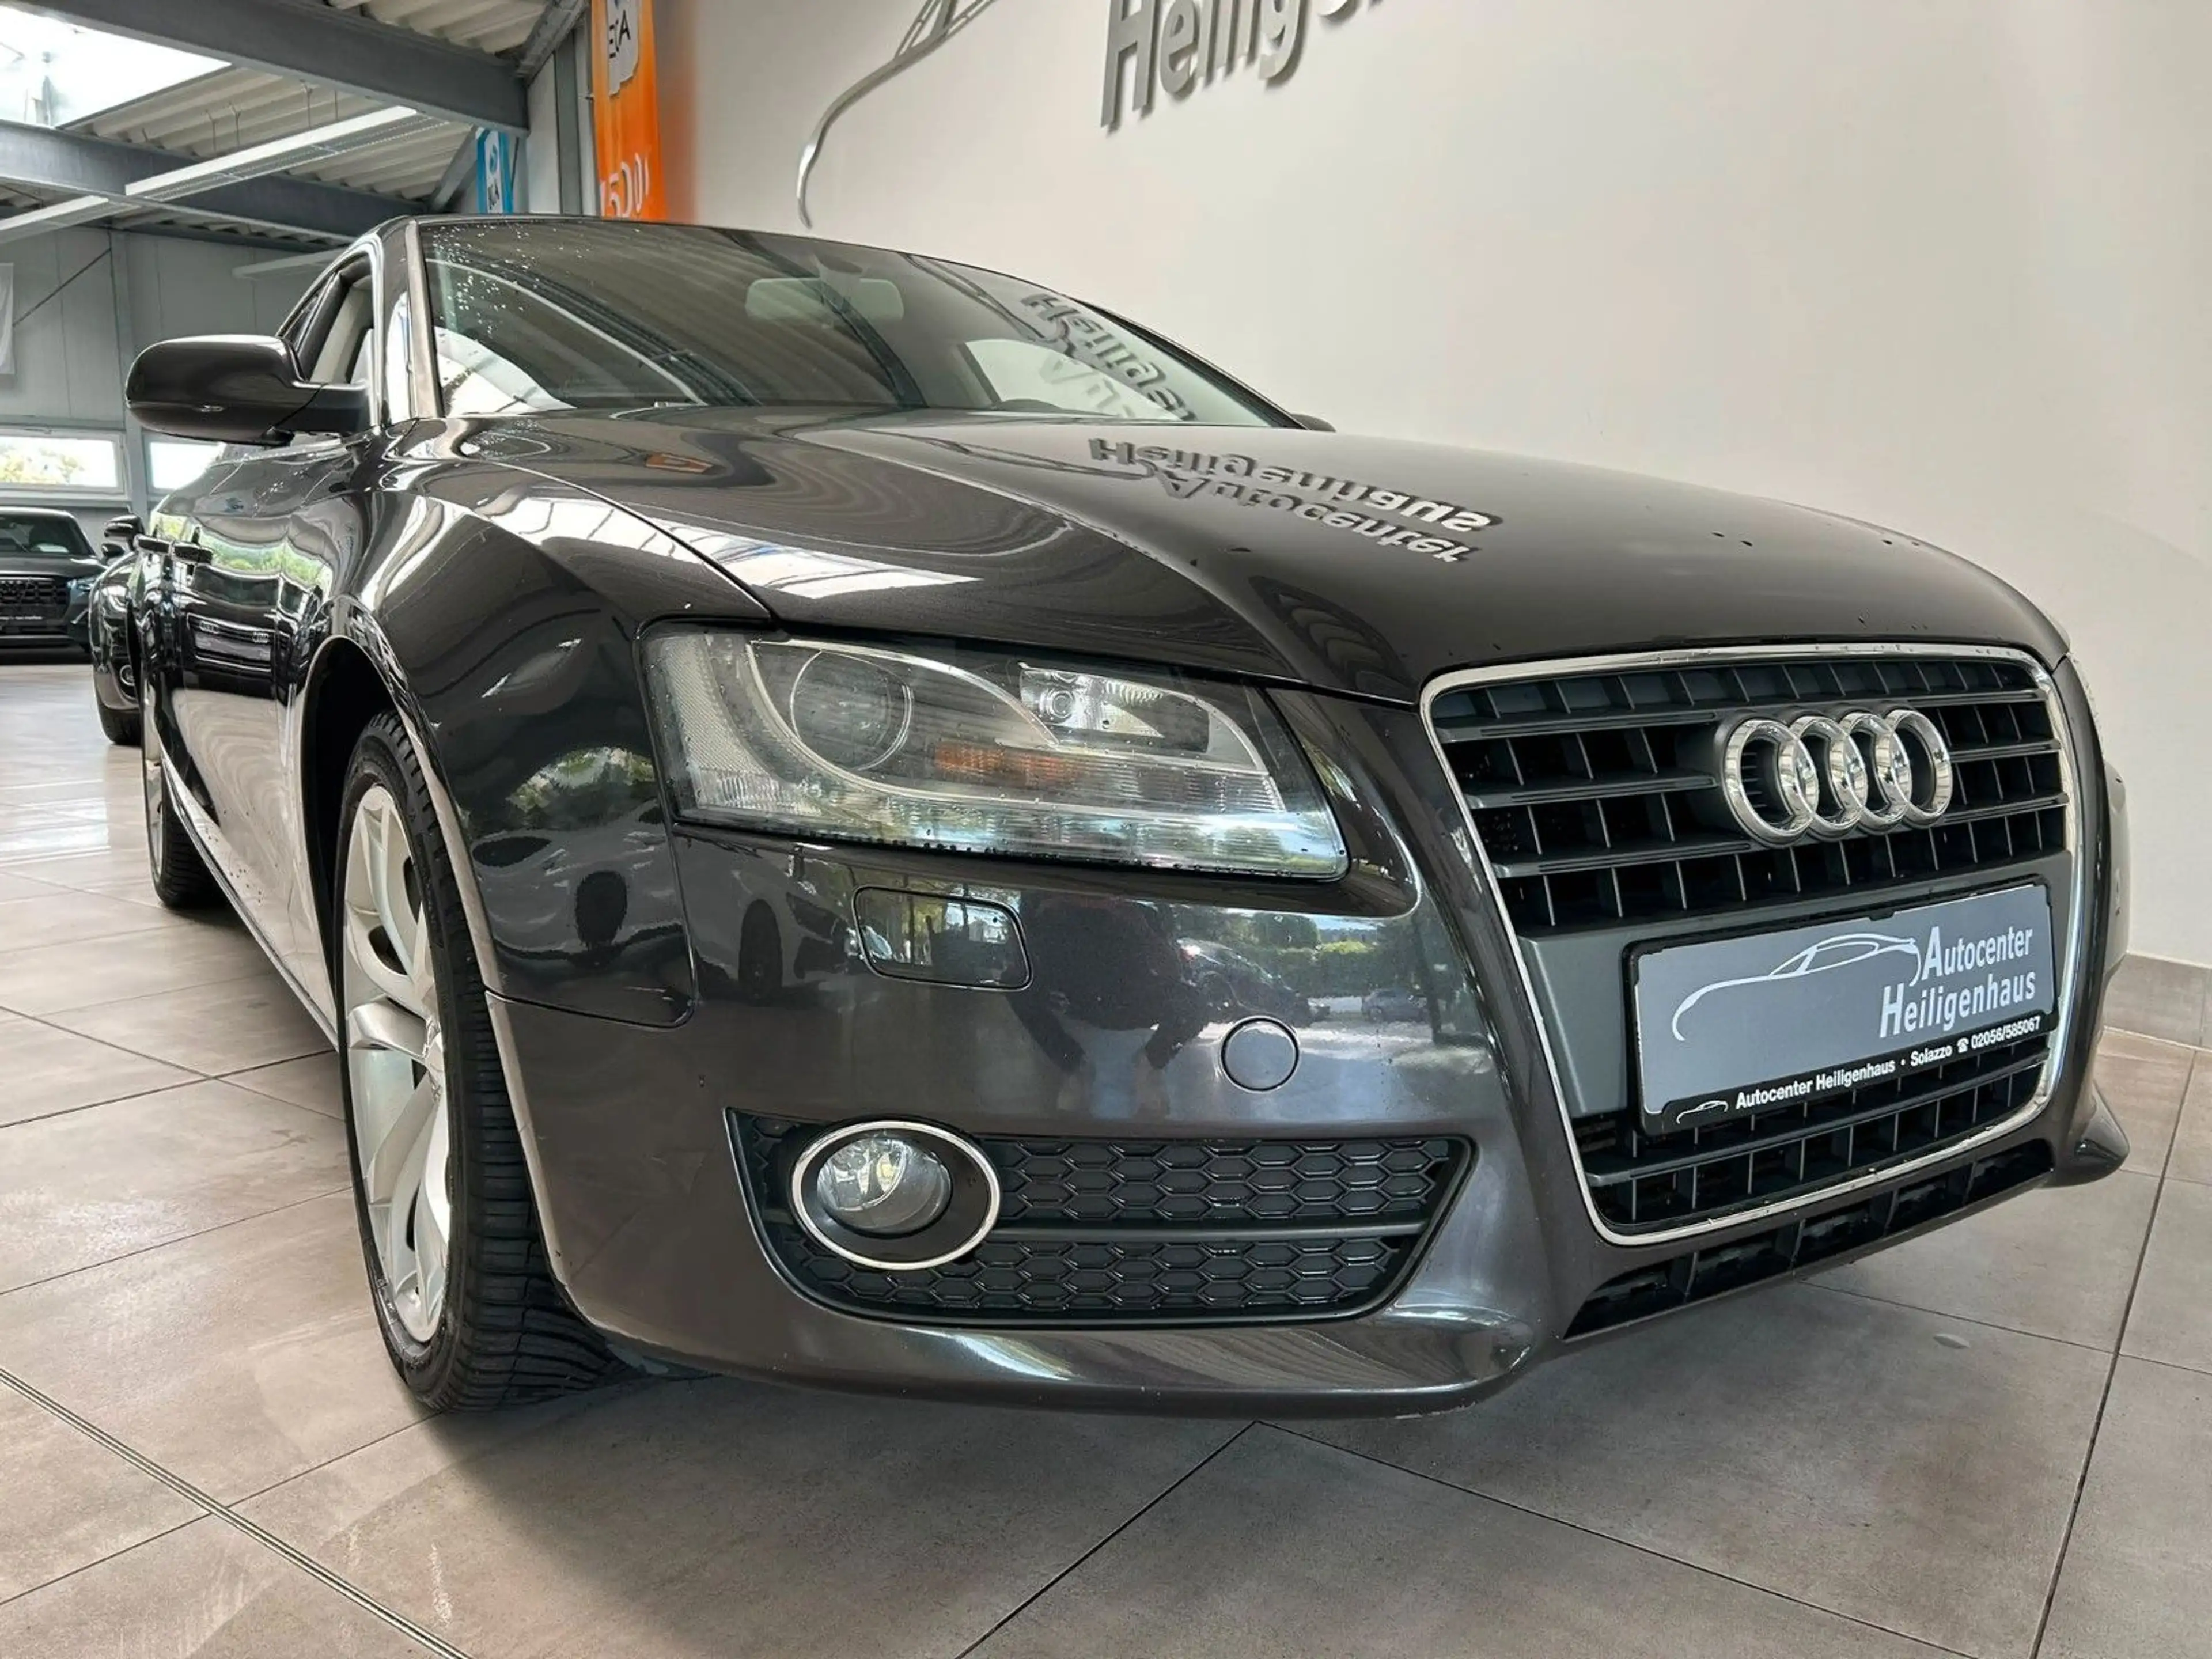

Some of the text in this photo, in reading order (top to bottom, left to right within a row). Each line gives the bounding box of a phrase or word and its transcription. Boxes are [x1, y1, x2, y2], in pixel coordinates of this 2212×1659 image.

[1101, 0, 1385, 127] Heilig
[1921, 926, 2033, 979] Autocenter
[1880, 971, 2035, 1037] Heiligenhaus
[1736, 1080, 1813, 1110] Autocenter
[1816, 1059, 1896, 1090] Heiligenhaus
[1910, 1044, 1953, 1067] Solazzo
